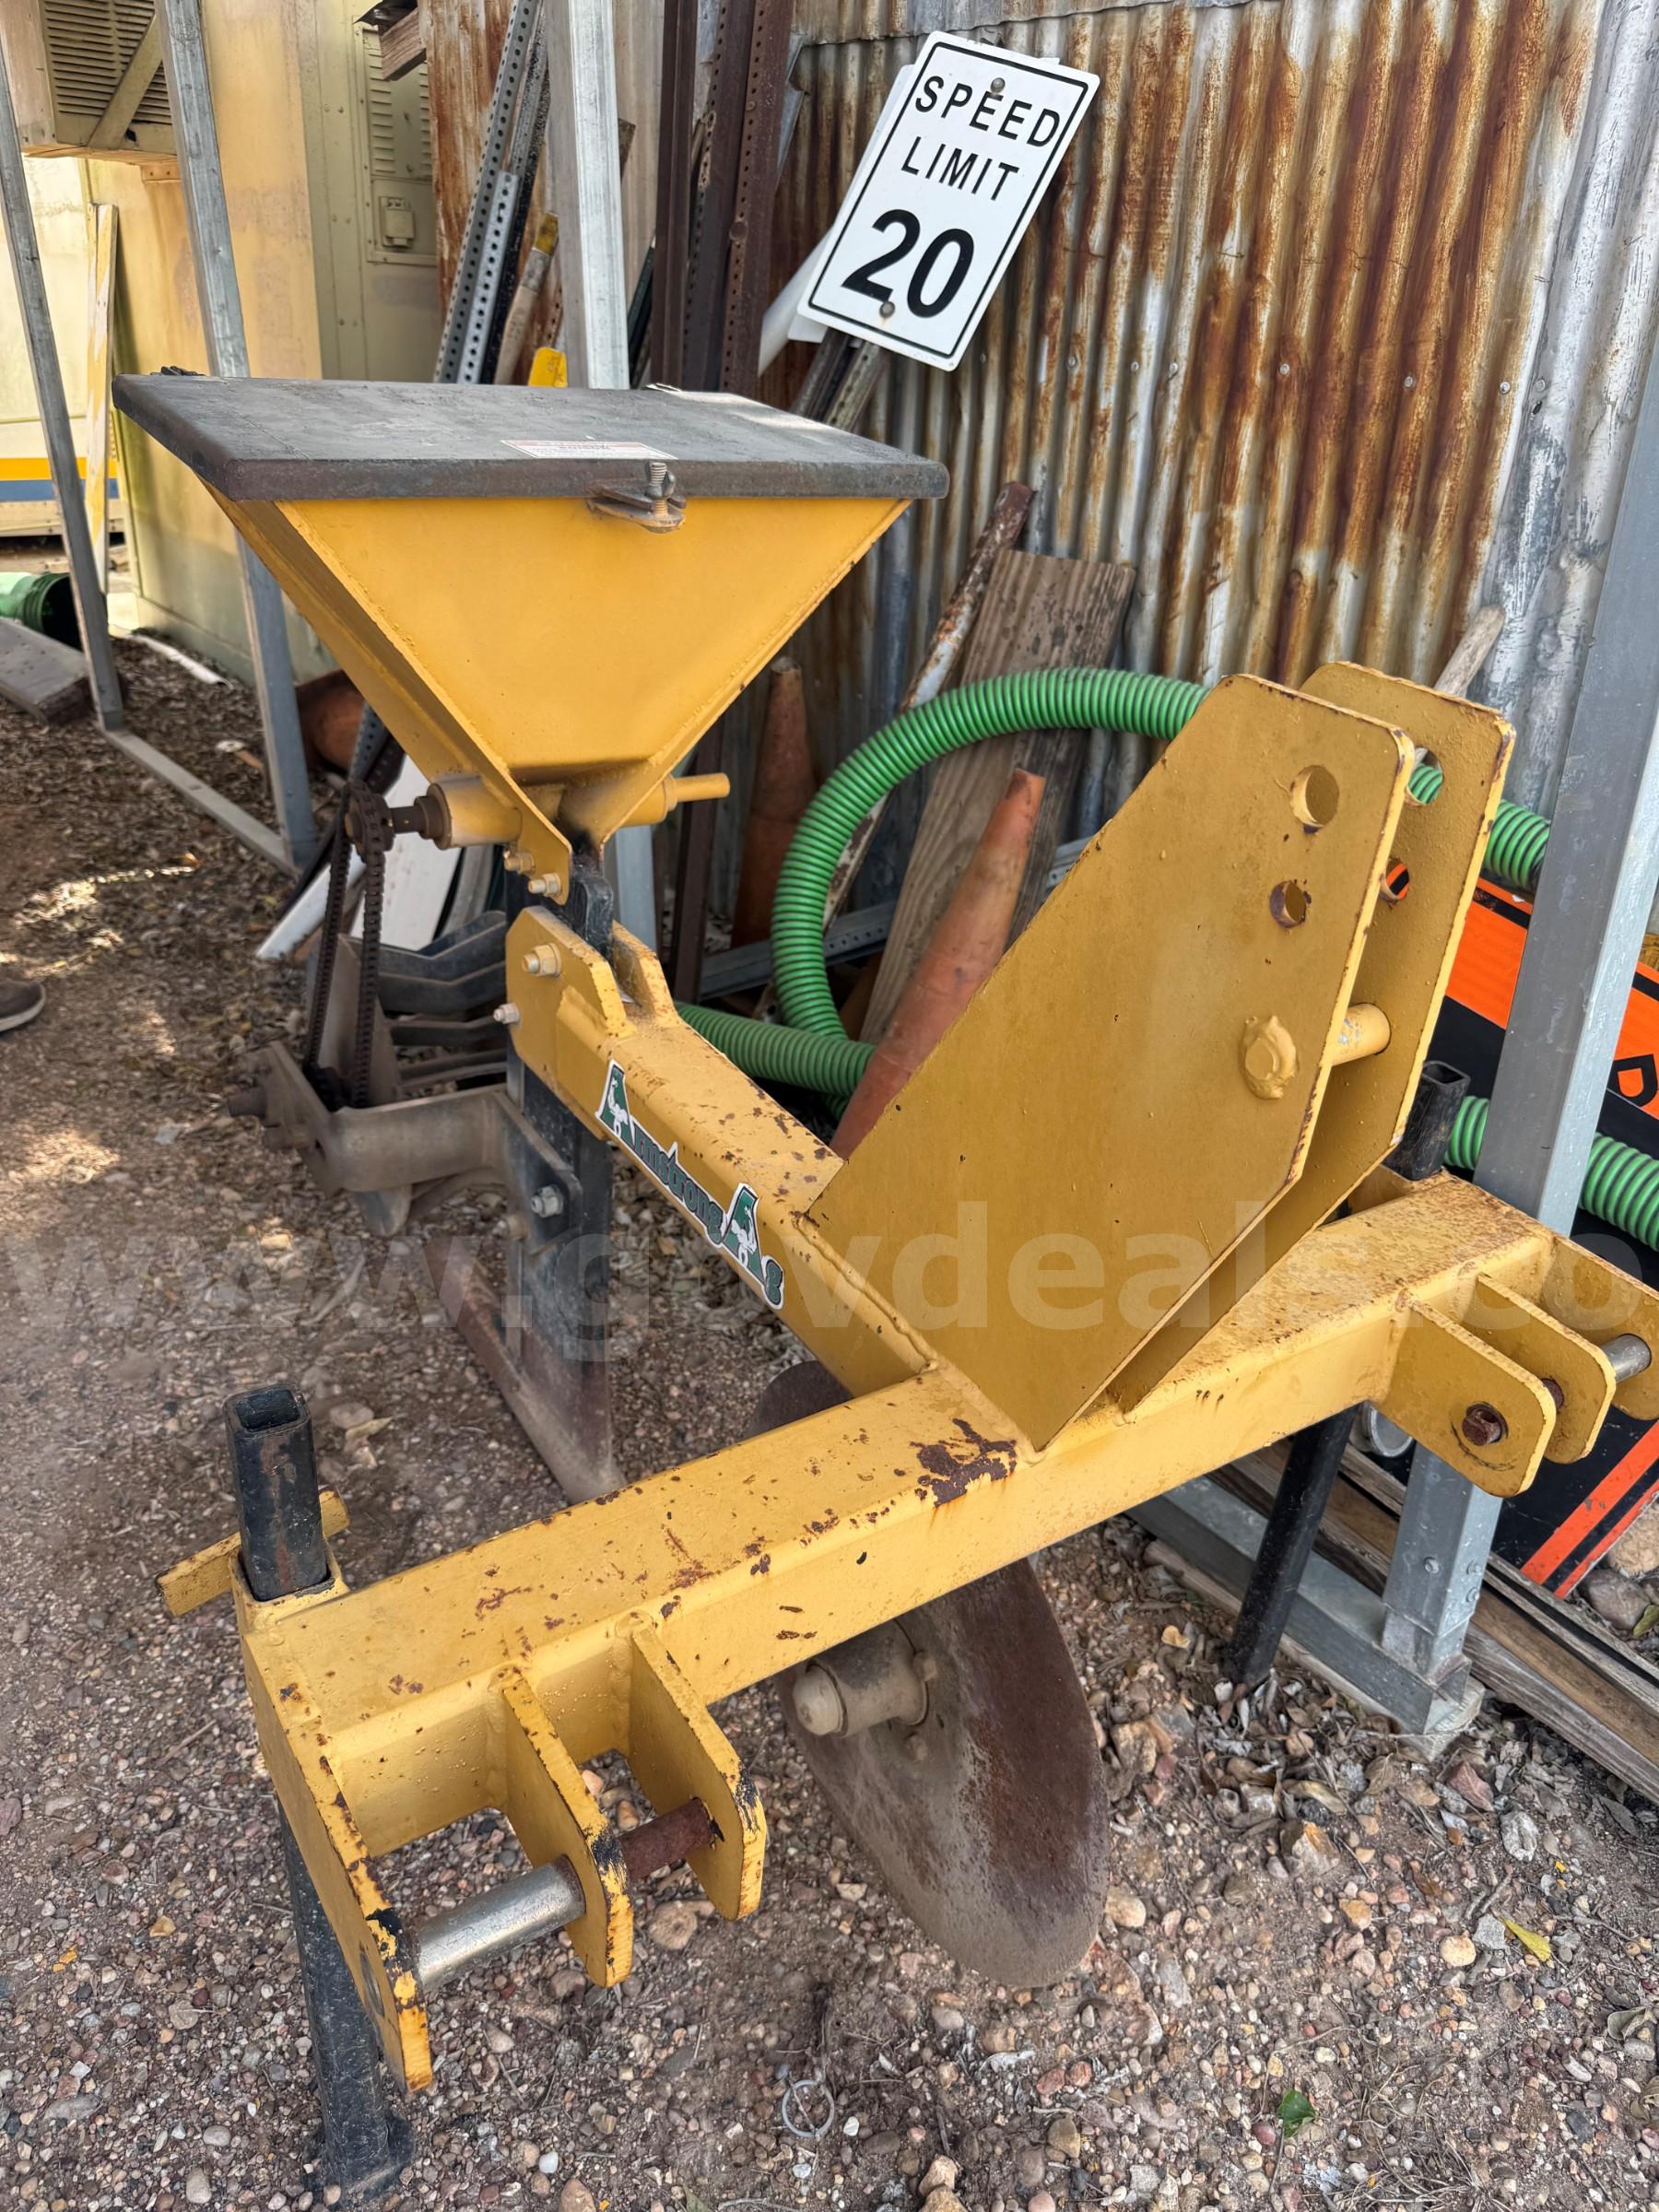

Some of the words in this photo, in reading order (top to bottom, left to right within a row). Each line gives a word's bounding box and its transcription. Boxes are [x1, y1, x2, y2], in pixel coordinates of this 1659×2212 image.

[915, 76, 1061, 147] SPEED
[900, 136, 1020, 201] LIMIT
[841, 208, 975, 319] 20
[597, 1062, 724, 1245] Armstrong
